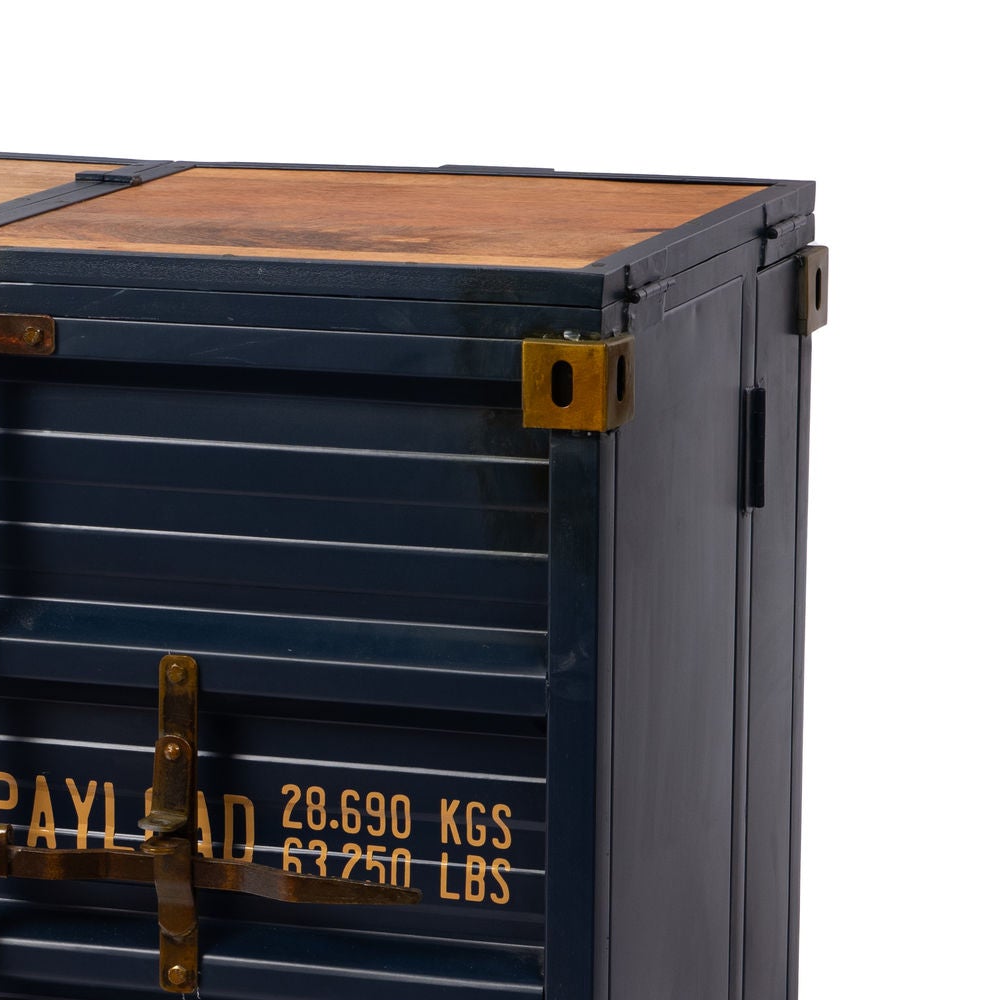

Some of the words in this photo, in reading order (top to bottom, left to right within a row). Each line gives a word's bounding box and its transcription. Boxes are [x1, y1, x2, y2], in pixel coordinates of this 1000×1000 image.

[281, 784, 411, 839] 28.690
[440, 798, 512, 849] KGS
[283, 837, 411, 888] 63250
[440, 852, 511, 904] LBS
